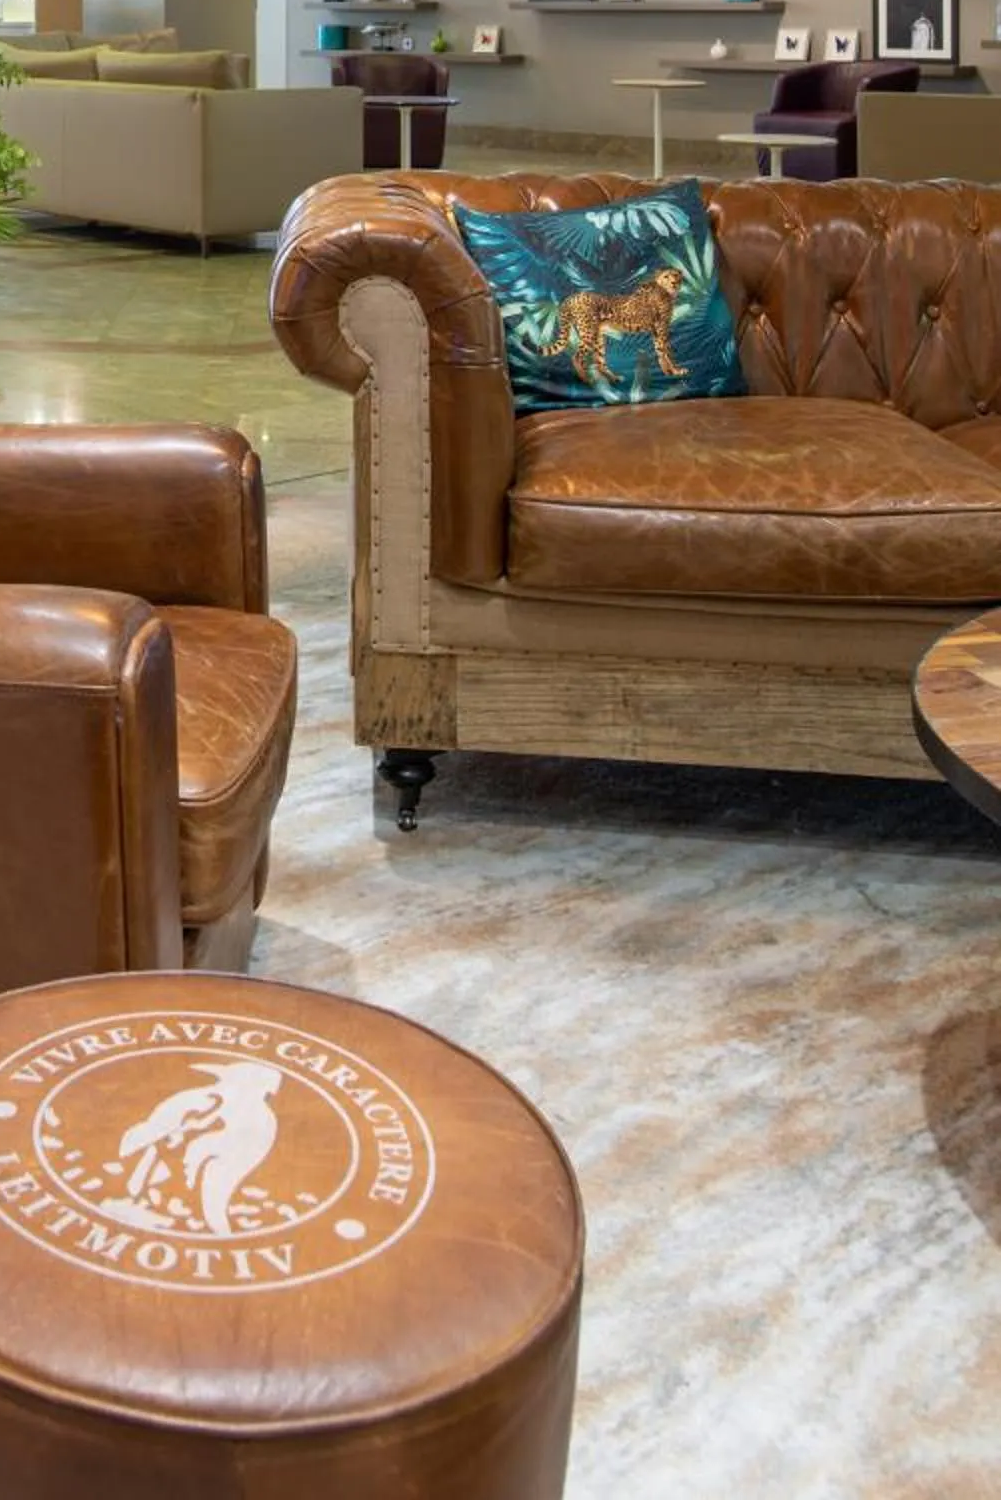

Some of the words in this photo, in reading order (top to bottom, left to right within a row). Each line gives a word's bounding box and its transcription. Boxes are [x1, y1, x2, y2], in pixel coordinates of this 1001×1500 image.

[9, 1025, 137, 1084] VIVRE
[149, 1022, 269, 1049] AVEC
[276, 1041, 414, 1205] CARACTERE
